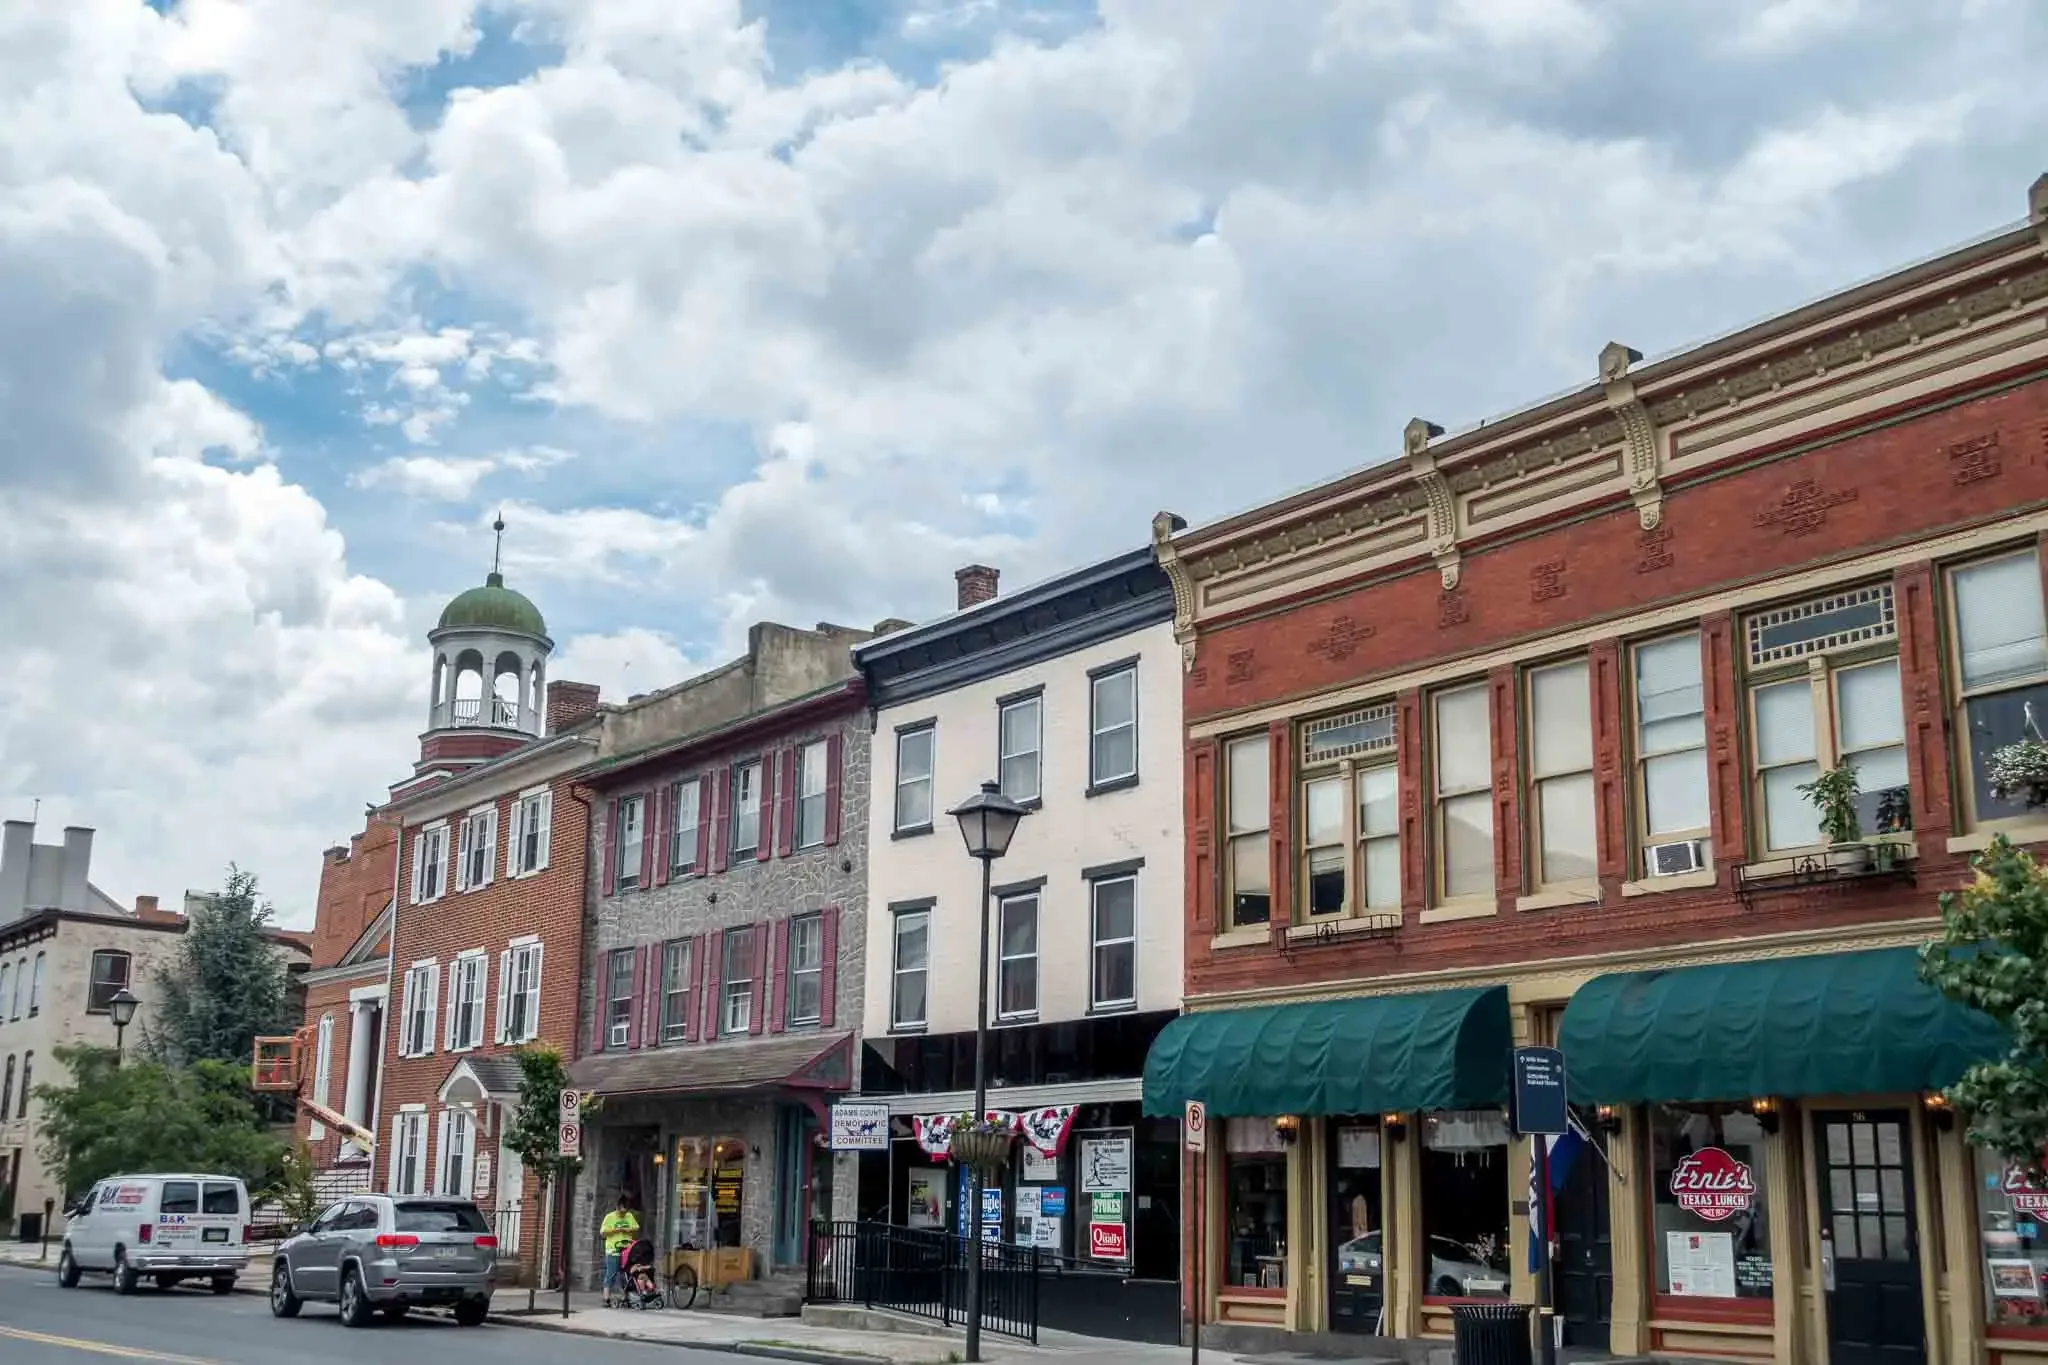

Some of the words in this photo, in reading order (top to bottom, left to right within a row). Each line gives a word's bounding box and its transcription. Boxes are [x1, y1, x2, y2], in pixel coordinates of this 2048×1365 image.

[860, 1108, 886, 1116] COUNTY
[834, 1119, 887, 1127] DEMOCRATIC
[836, 1136, 883, 1145] COMMITTEE
[1673, 1160, 1752, 1190] Ernie's
[1683, 1194, 1713, 1206] TEXAS
[1716, 1194, 1745, 1206] LUNCH
[2018, 1195, 2048, 1208] TEXA
[1093, 1199, 1121, 1213] STOKES
[1701, 1208, 1715, 1217] SINCE
[159, 1215, 185, 1224] B&K
